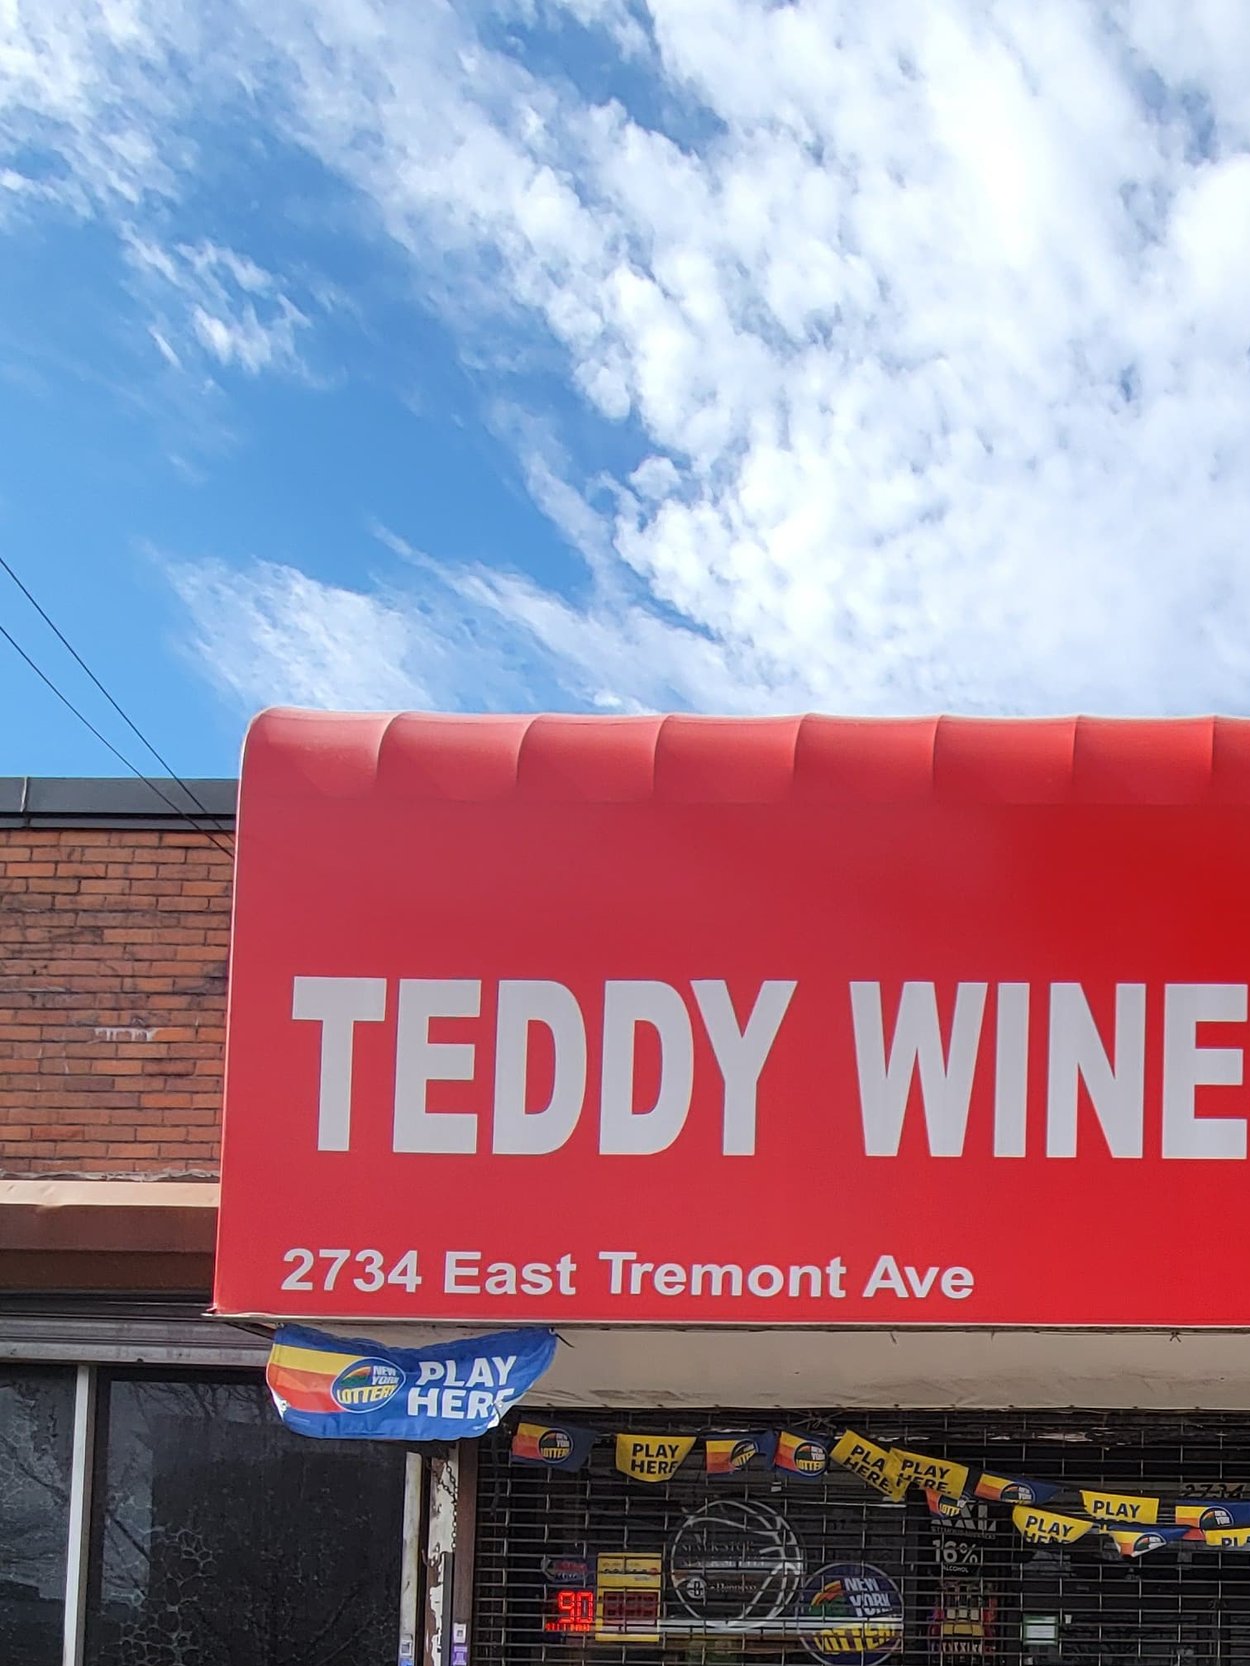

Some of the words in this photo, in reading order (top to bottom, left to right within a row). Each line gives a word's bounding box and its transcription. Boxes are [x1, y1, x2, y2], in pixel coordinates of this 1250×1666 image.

[292, 976, 797, 1157] TEDDY
[281, 1248, 421, 1293] 2734
[445, 1251, 577, 1296] East
[599, 1251, 847, 1297] Tremont
[863, 1254, 974, 1299] Ave
[419, 1356, 517, 1387] PLAY
[632, 1443, 680, 1458] PLAY
[851, 1444, 886, 1473] PLA
[901, 1458, 951, 1479] PLAY
[1092, 1500, 1141, 1518] PLAY
[1025, 1515, 1075, 1537] PLAY
[932, 1539, 978, 1564] 16%
[844, 1578, 879, 1591] NEW
[558, 1591, 594, 1624] 90
[850, 1593, 892, 1617] YORK
